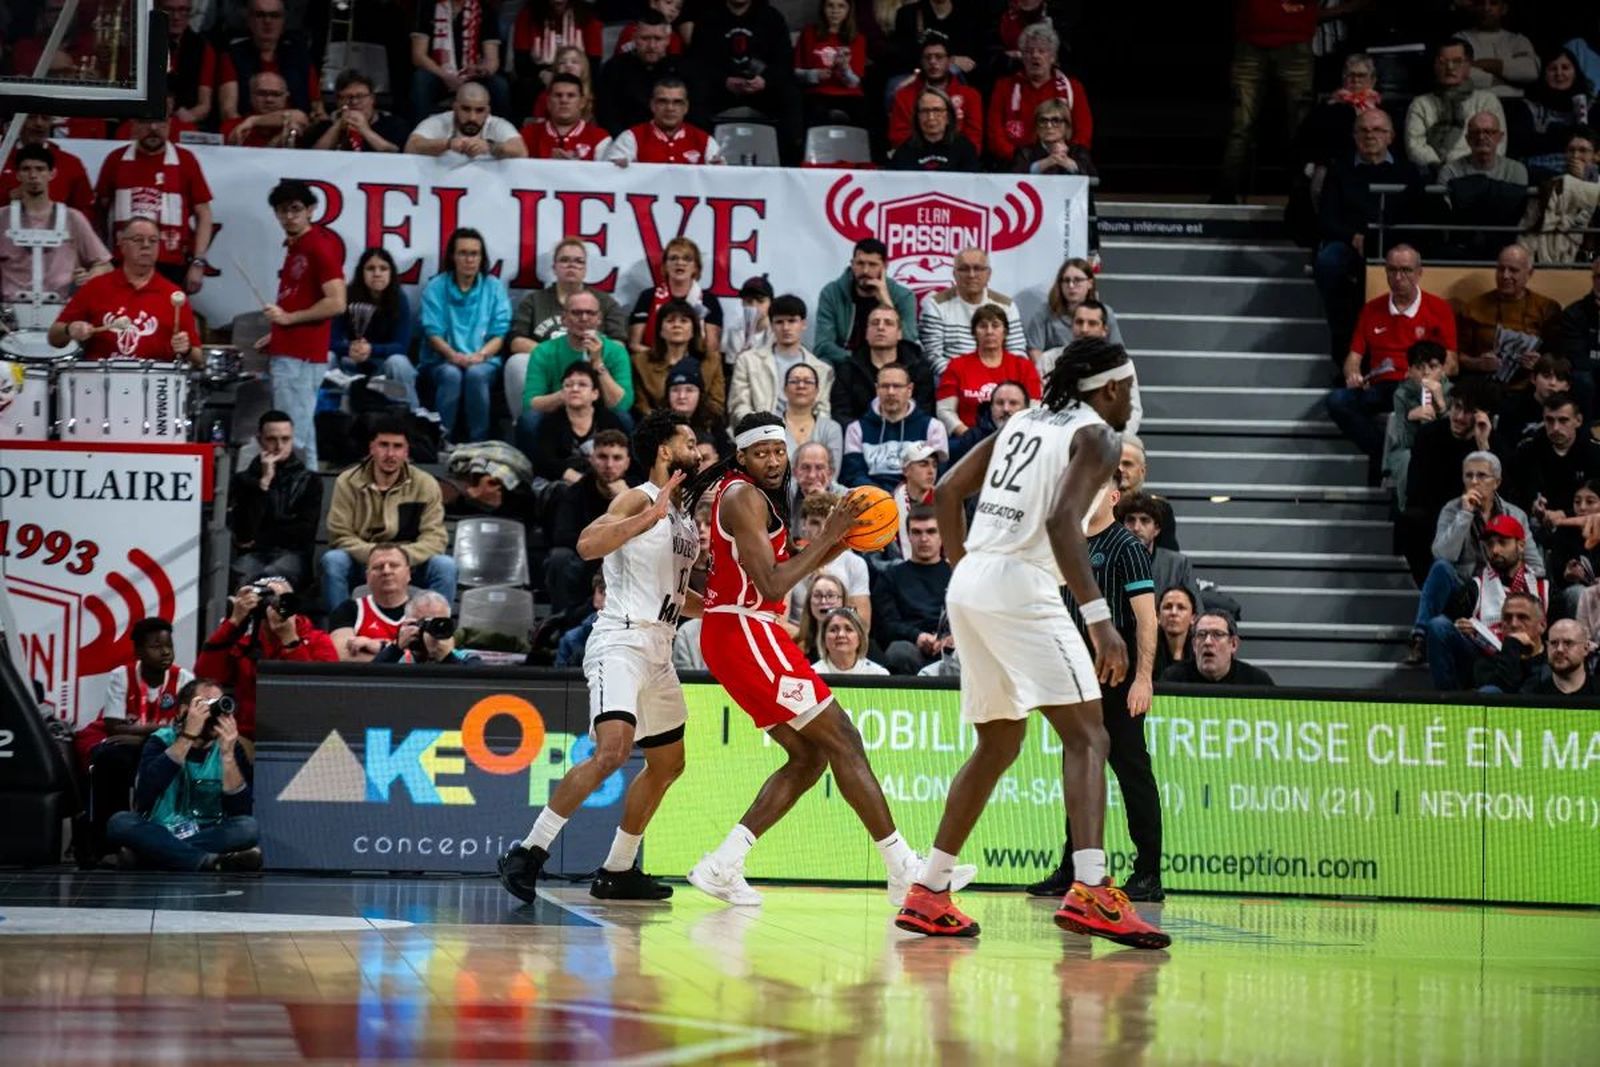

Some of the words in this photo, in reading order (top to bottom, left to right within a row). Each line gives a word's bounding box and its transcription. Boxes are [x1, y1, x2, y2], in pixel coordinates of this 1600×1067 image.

[917, 207, 951, 225] ELAN
[887, 223, 979, 259] PASSION
[156, 376, 168, 437] THOMANN
[990, 431, 1042, 493] 32
[0, 467, 194, 502] OPULAIRE
[1367, 715, 1447, 768] CLÉ
[1466, 726, 1522, 769] EN
[1229, 783, 1310, 813] DIJON
[1319, 787, 1376, 822] (21)
[1420, 789, 1534, 823] NEYRON
